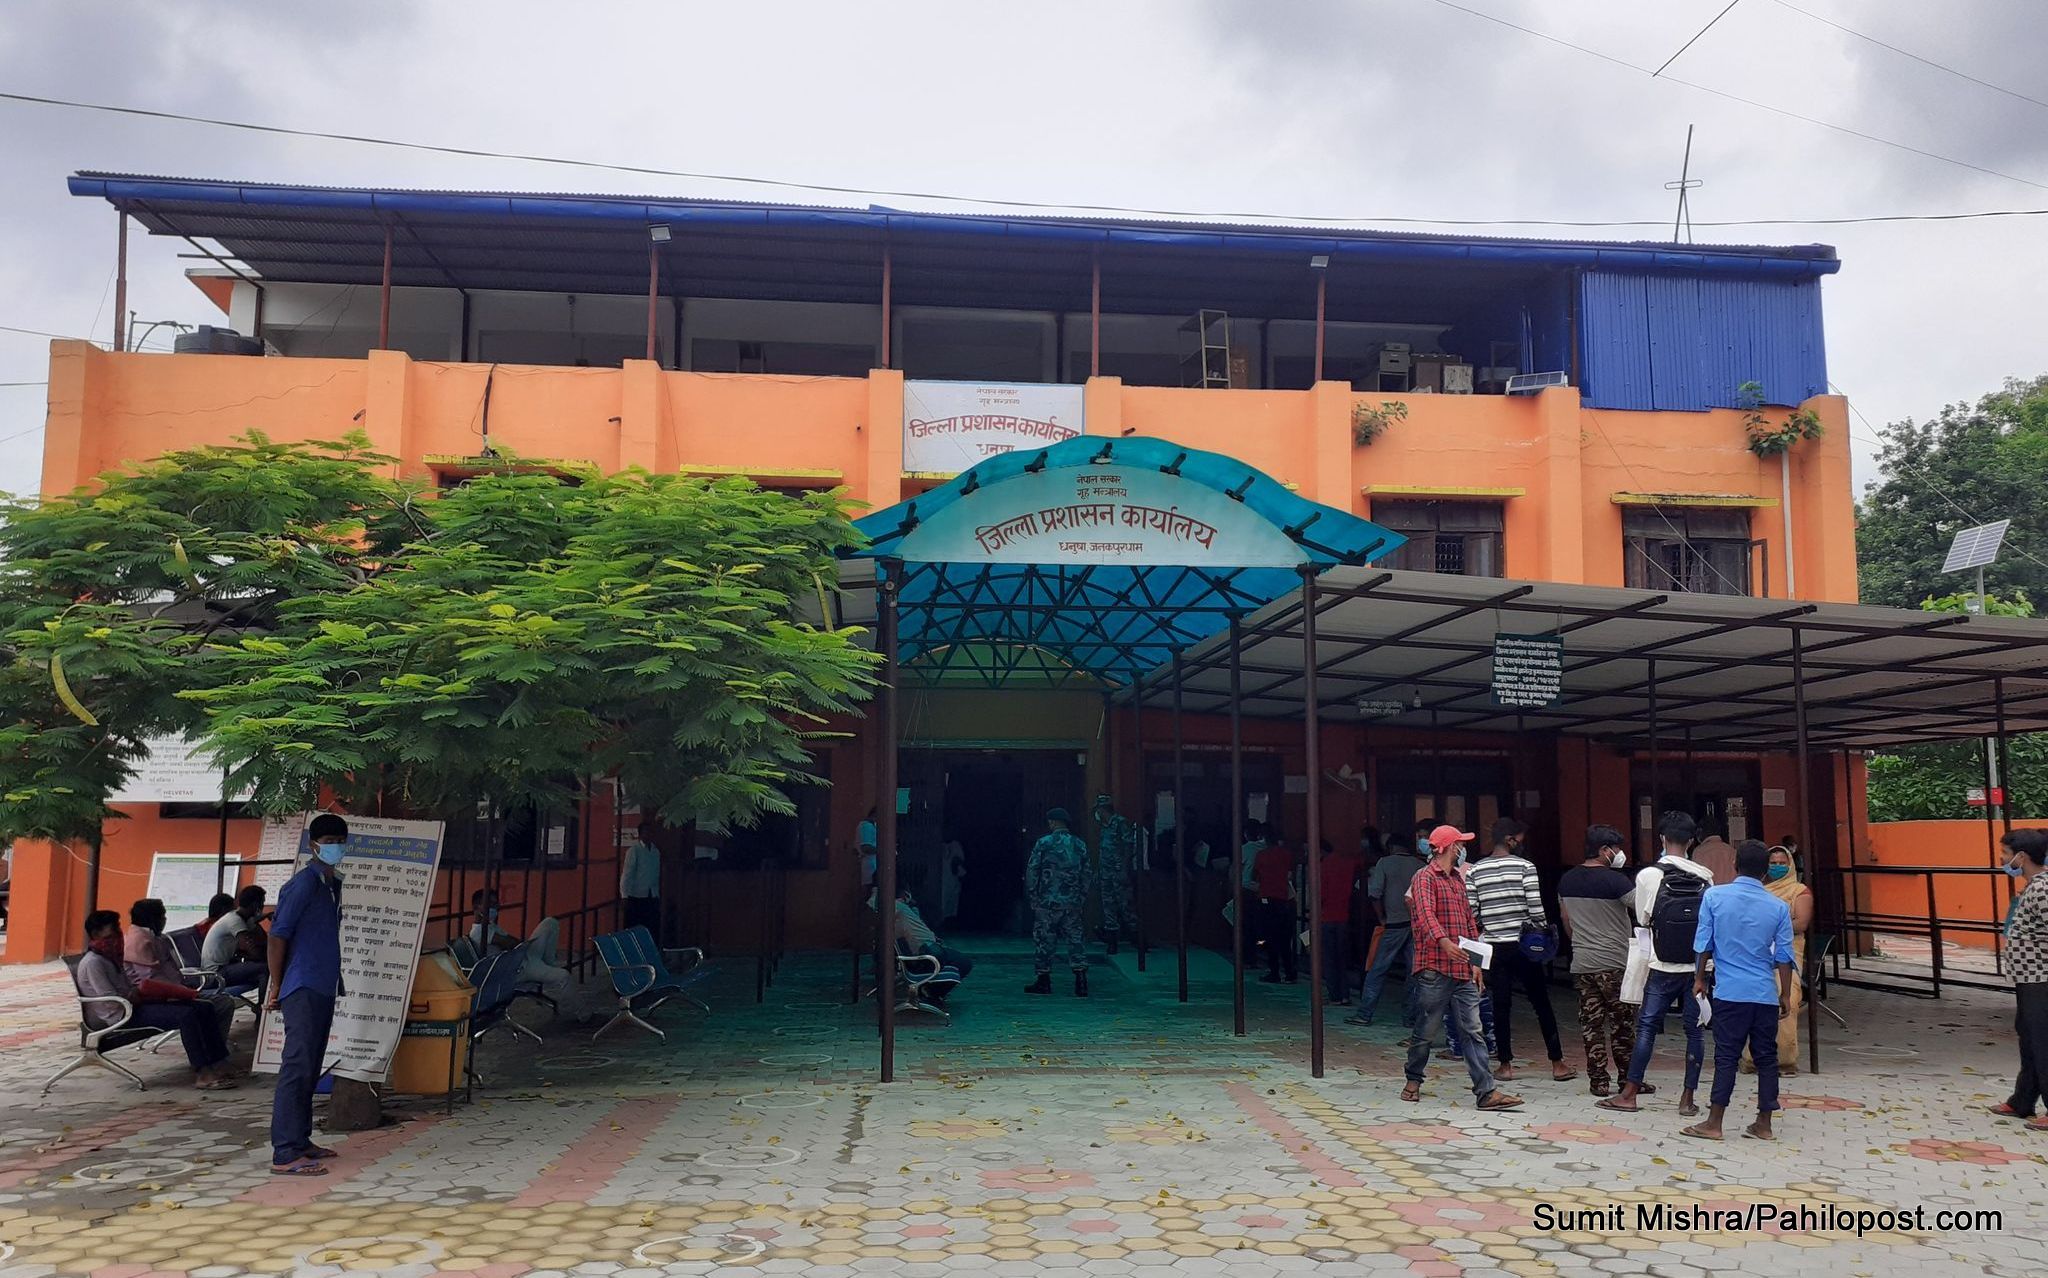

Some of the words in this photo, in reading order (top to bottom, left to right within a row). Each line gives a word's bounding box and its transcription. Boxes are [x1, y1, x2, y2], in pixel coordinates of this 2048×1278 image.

[909, 418, 957, 438] जिल्ला
[960, 414, 1018, 433] प्रशासन
[1076, 474, 1098, 485] नेपाल
[1100, 475, 1121, 485] सरकार
[1077, 487, 1090, 499] गृह
[975, 513, 1038, 555] जिल्ला
[1038, 503, 1114, 533] प्रशासन
[1121, 506, 1217, 550] कार्यालय
